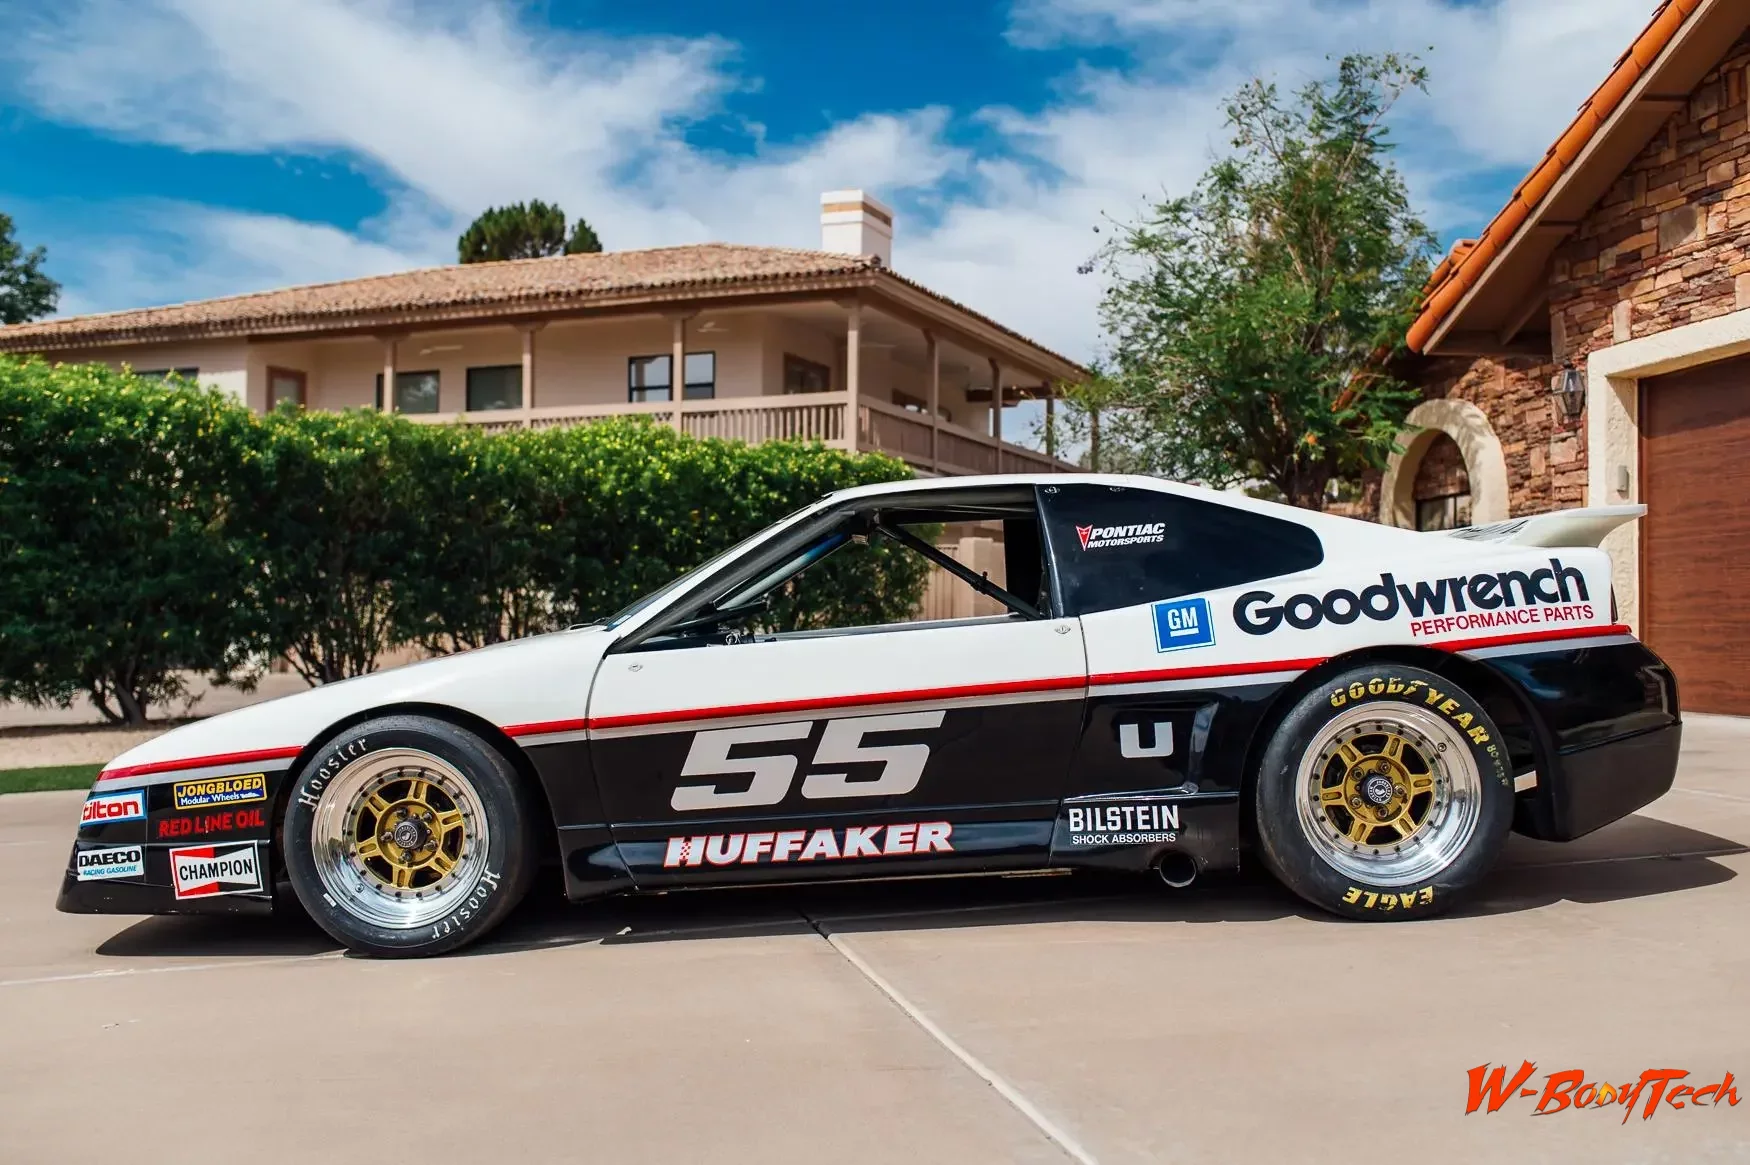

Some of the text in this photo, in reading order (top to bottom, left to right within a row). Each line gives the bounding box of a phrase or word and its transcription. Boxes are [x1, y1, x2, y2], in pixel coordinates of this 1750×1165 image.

[1088, 535, 1165, 549] MOTORSPORTS
[1091, 522, 1166, 538] PONTIAC
[1232, 558, 1589, 637] Goodwrench
[1167, 607, 1198, 629] GM
[1410, 604, 1595, 638] PERFORMANCE PARTS
[1119, 721, 1175, 759] U
[670, 710, 947, 812] 55
[177, 777, 262, 797] JONGBLOED
[298, 737, 369, 812] Hoosier
[82, 800, 140, 821] tilton
[180, 791, 240, 806] Modular Wheels
[158, 810, 265, 838] RED LINE OIL
[1068, 804, 1180, 832] BILSTEIN
[663, 821, 954, 868] HUFFAKER
[1072, 832, 1177, 844] SHOCK ABSORBERS
[78, 850, 142, 868] DAECO
[82, 864, 137, 877] RACING GASOLINE
[179, 858, 253, 882] CHAMPION
[431, 867, 501, 940] Hoosier
[1342, 885, 1436, 912] EAGLE
